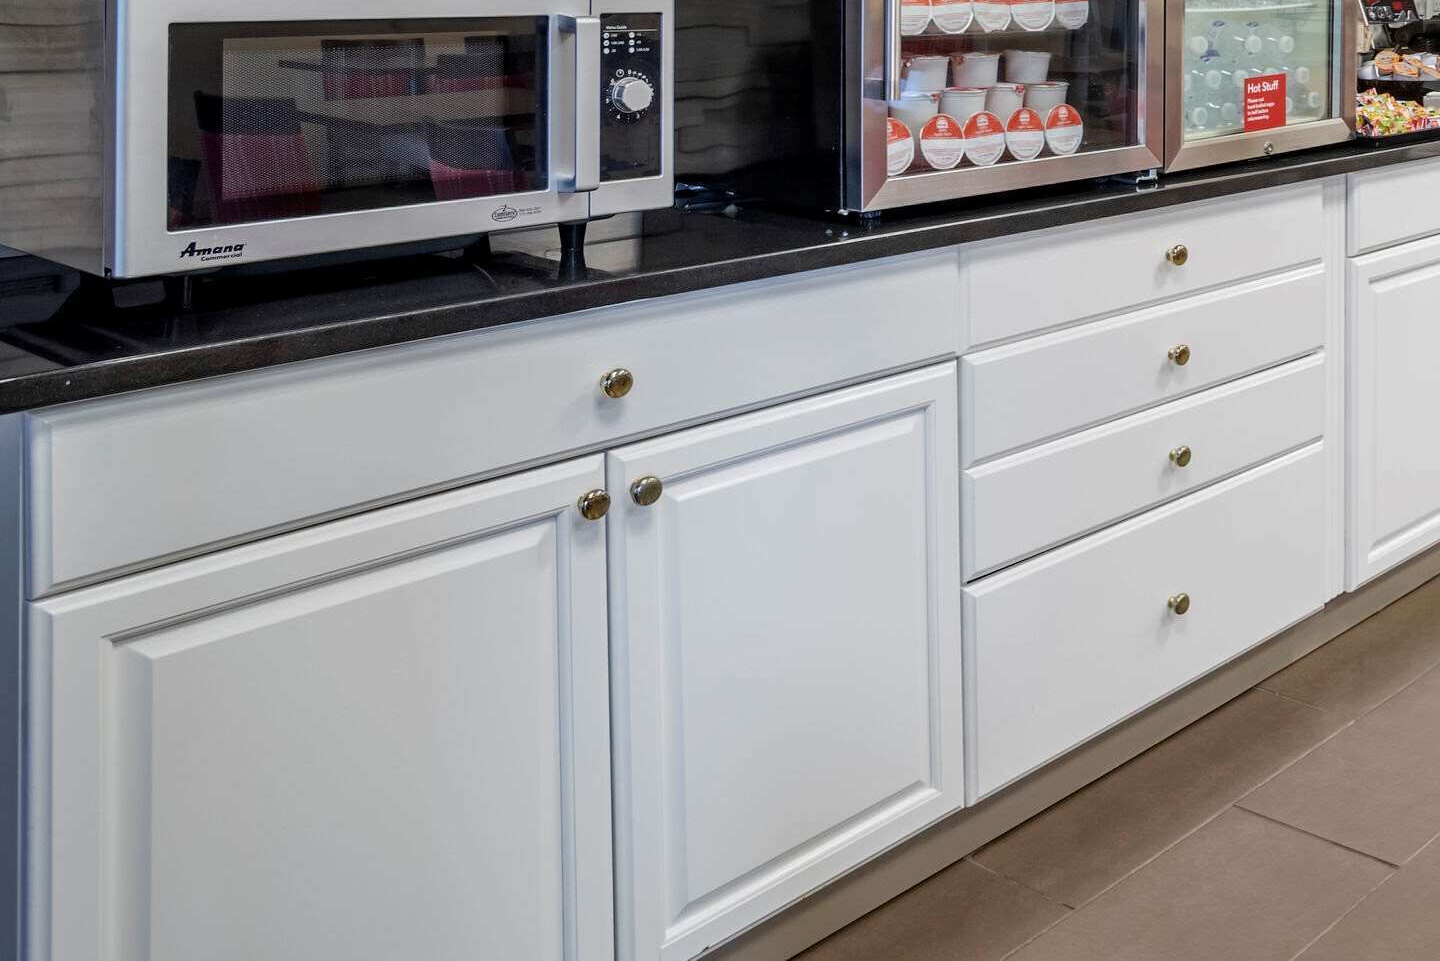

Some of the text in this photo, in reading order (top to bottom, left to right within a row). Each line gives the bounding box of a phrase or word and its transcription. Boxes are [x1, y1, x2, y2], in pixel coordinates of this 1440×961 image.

[1247, 80, 1279, 94] Hot Stuff
[180, 241, 245, 258] Amana
[200, 252, 242, 262] Commercial
